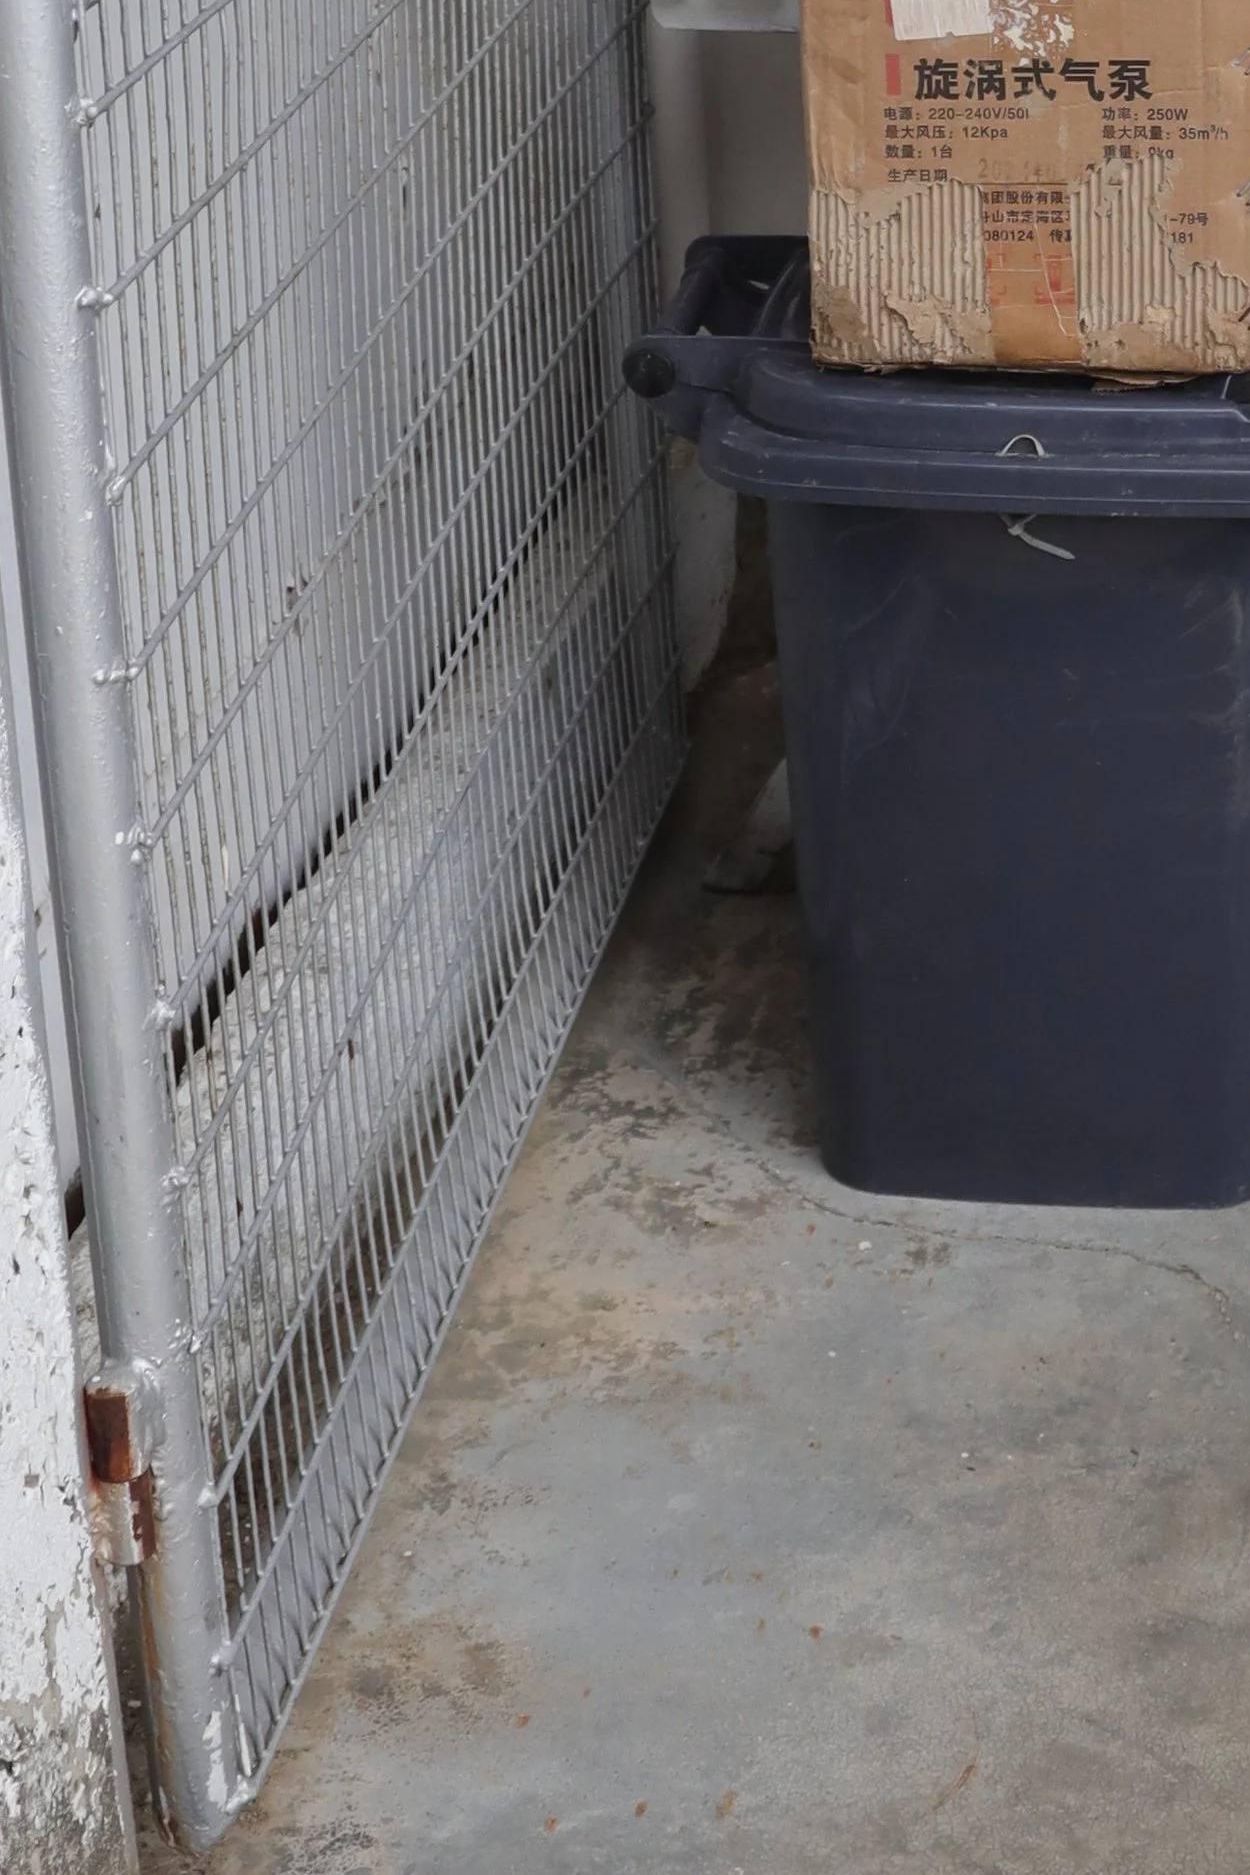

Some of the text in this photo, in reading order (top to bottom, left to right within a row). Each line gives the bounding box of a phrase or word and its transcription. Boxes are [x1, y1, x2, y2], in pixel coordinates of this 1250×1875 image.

[913, 57, 1153, 102] 旋涡式气泵
[982, 191, 1070, 204] 团股份有限
